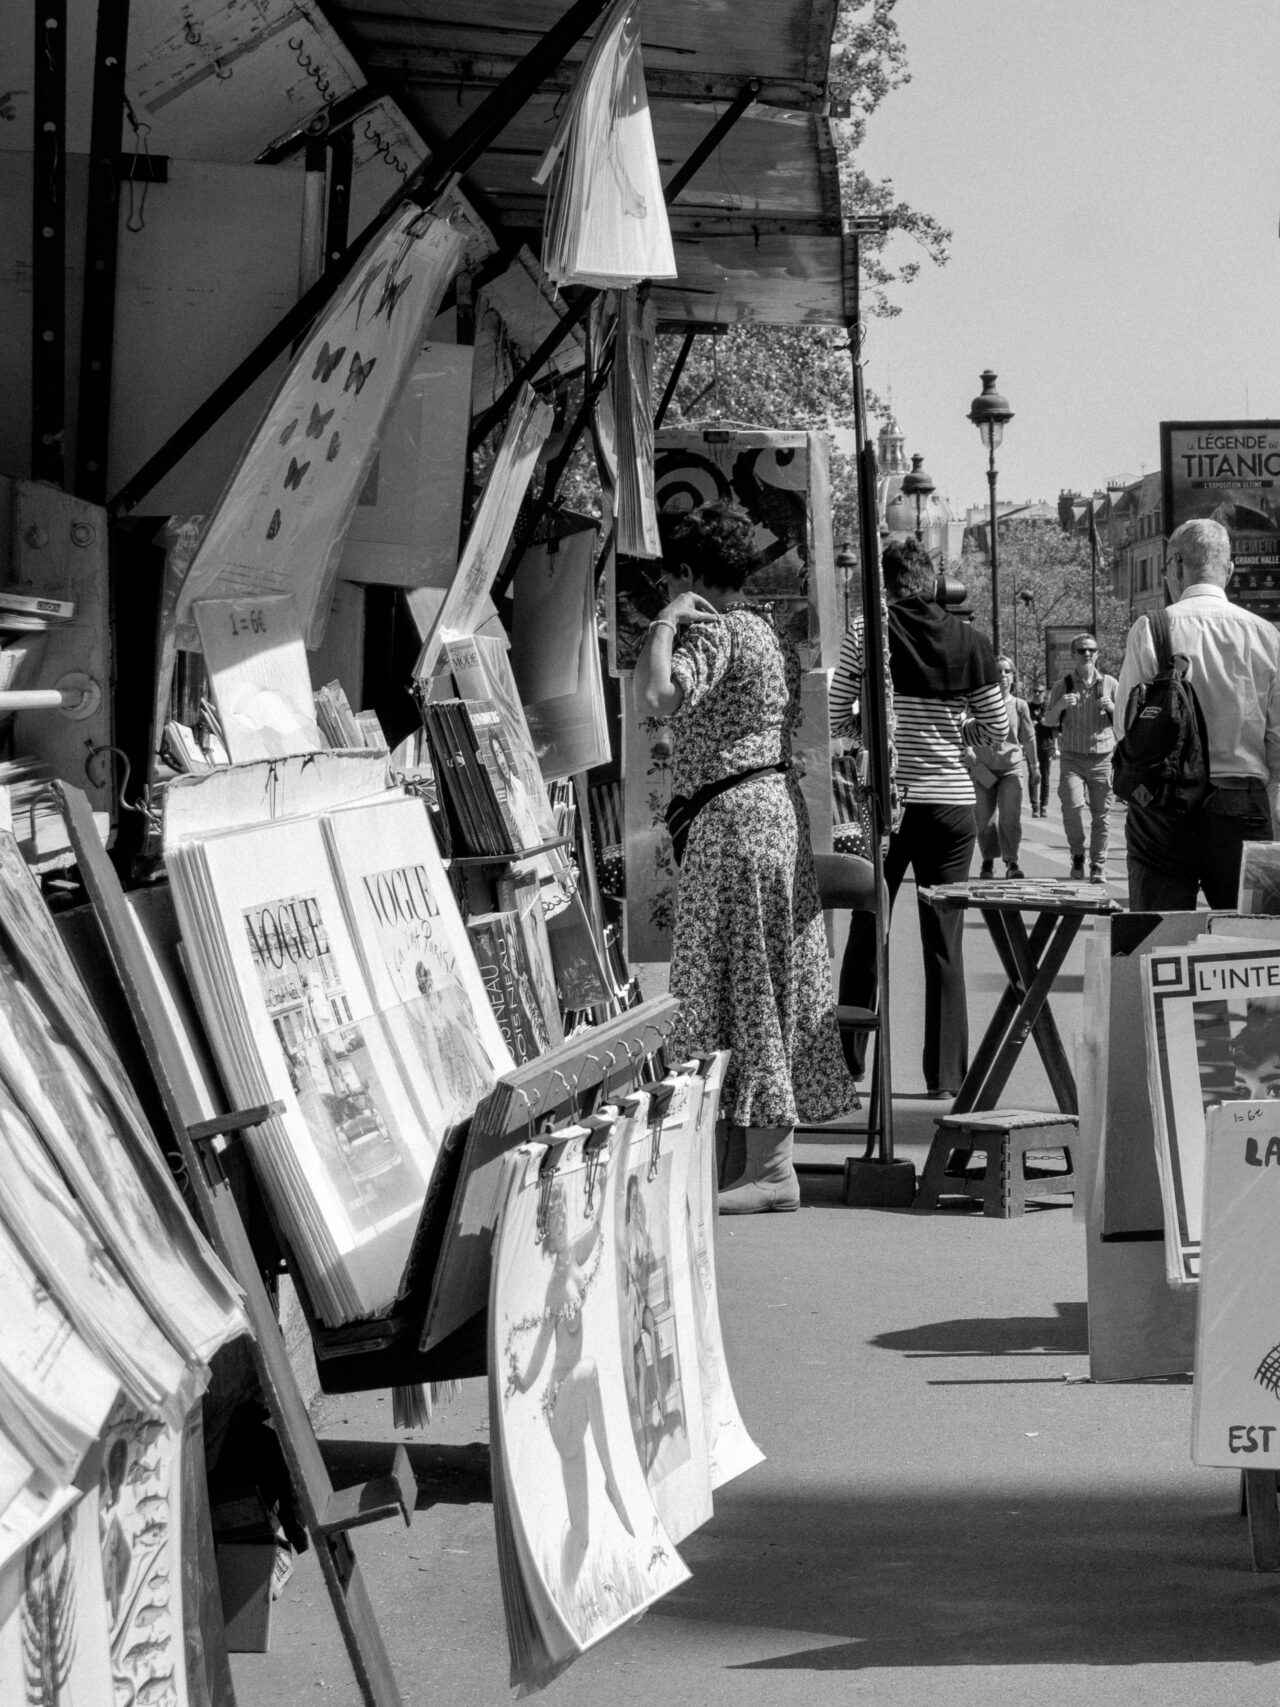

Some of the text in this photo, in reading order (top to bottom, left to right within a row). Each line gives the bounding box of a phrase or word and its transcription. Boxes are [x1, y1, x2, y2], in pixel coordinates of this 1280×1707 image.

[1197, 433, 1266, 451] LÉGENDE
[361, 865, 440, 928] VOGUE
[243, 897, 329, 970] VOGUE
[1228, 1425, 1277, 1454] EST
